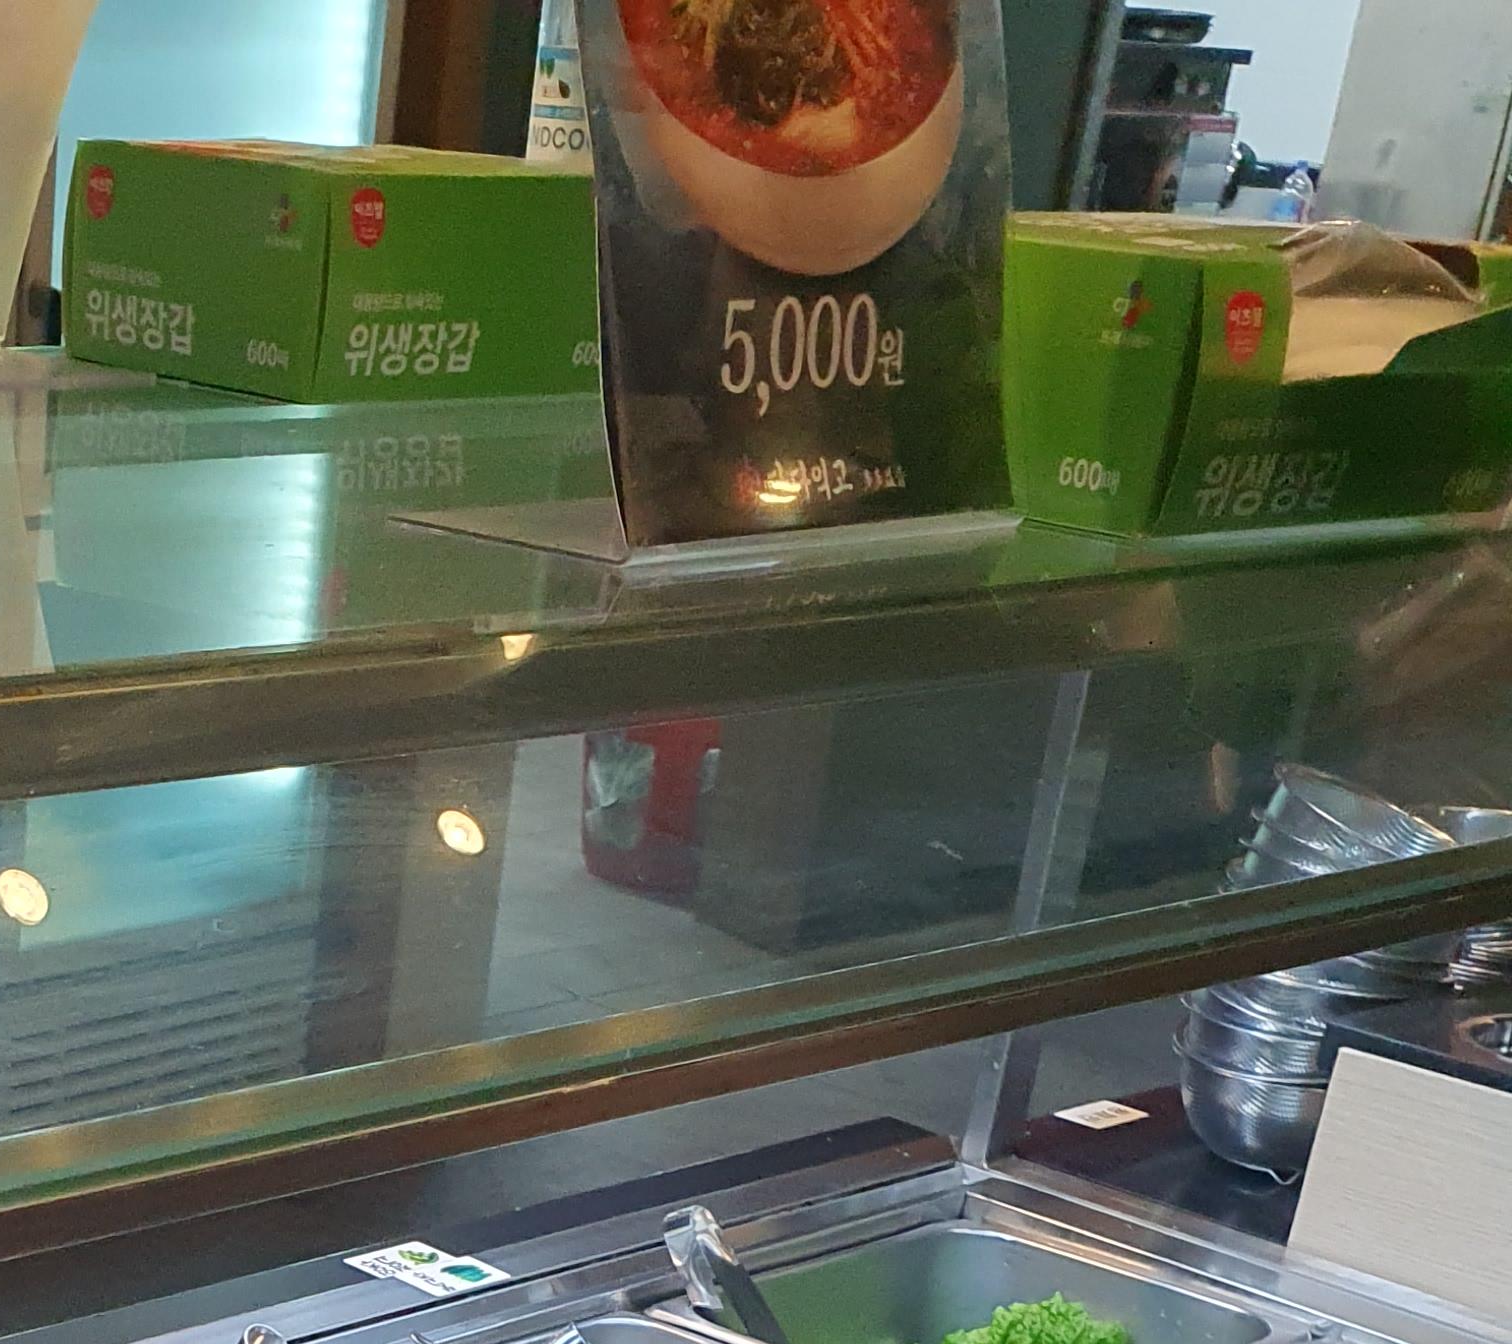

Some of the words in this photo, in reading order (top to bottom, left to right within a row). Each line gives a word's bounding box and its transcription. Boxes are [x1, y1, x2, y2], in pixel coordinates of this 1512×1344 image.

[85, 289, 195, 356] 위생장갑
[344, 320, 481, 377] 위생장갑
[720, 293, 906, 417] 5,000원
